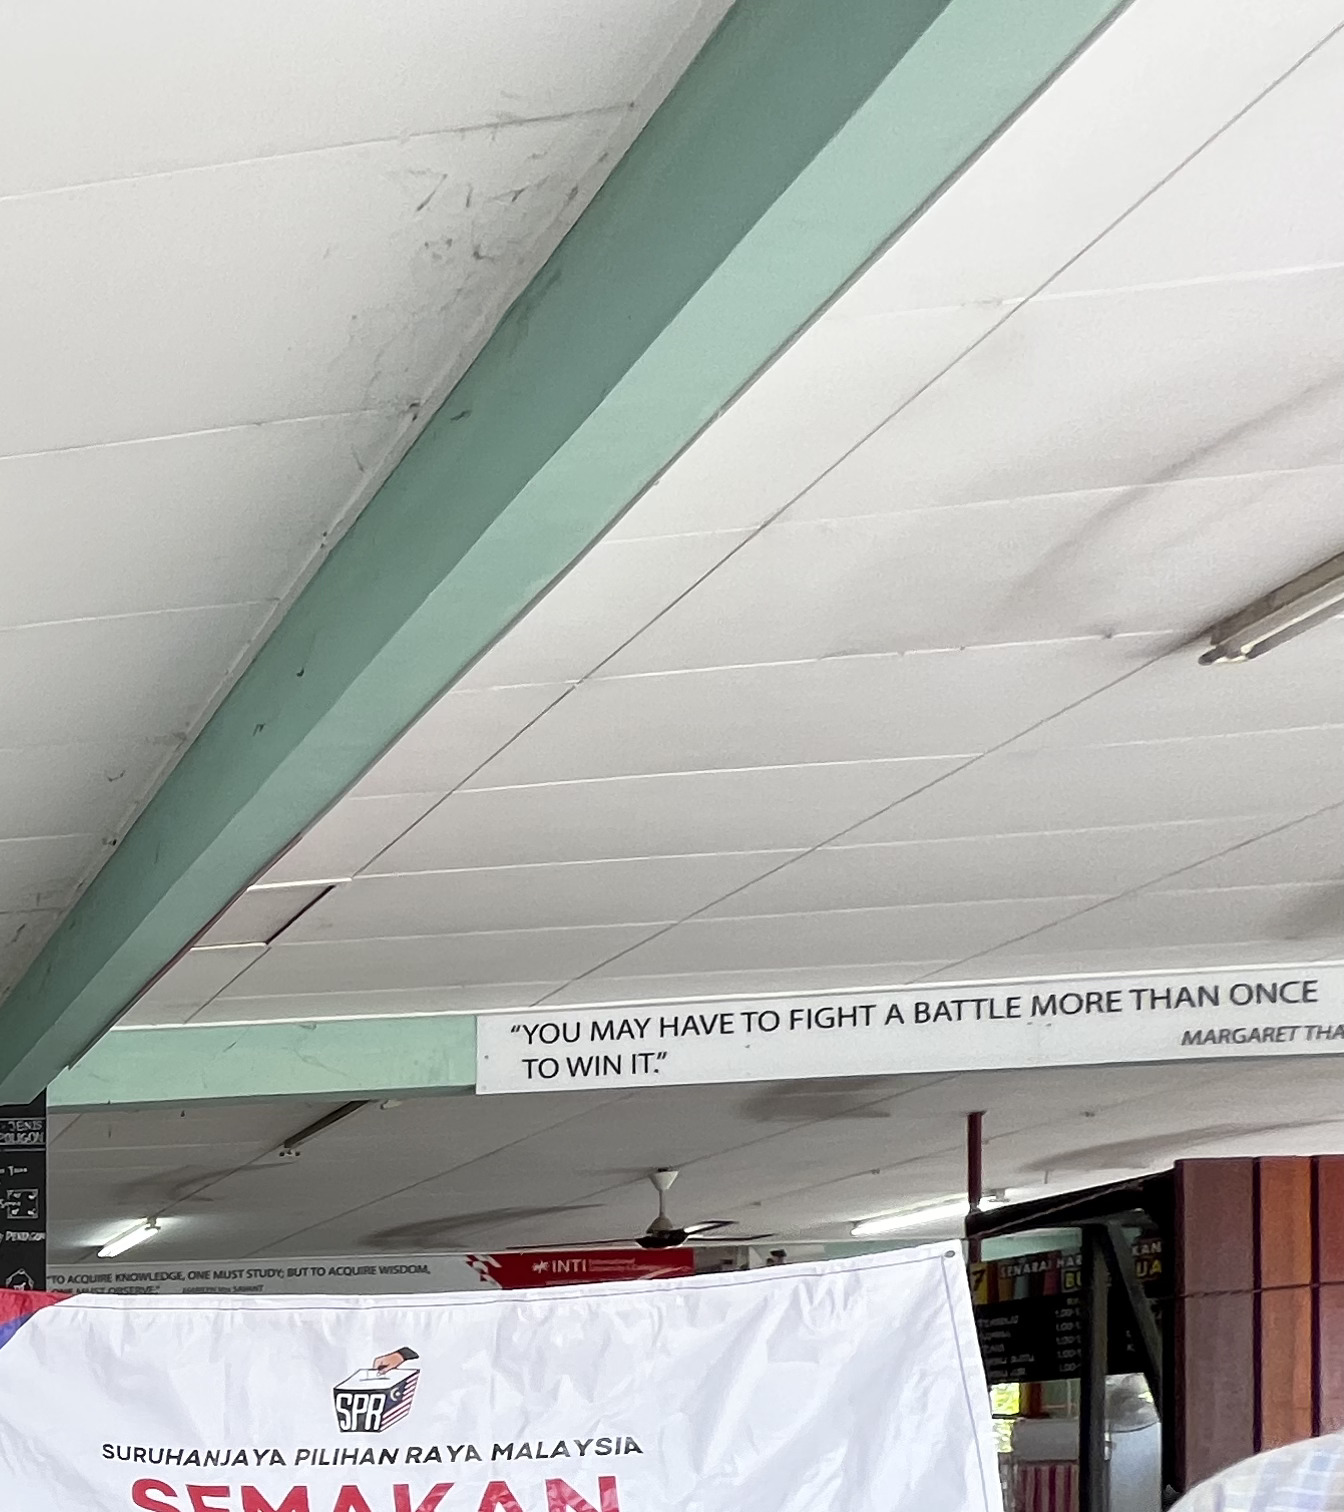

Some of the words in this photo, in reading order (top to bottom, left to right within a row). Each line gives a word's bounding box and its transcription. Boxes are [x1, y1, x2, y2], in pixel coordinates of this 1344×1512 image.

[510, 1021, 581, 1045] "YOU
[590, 1017, 652, 1042] MAY
[659, 1012, 735, 1038] HAVE
[741, 1010, 780, 1033] TO
[789, 1004, 877, 1031] FIGHT
[884, 1003, 905, 1026] A
[914, 995, 1022, 1024] BATTLE
[1030, 989, 1123, 1017] MORE
[1129, 983, 1221, 1010] THAN
[1229, 979, 1319, 1007] ONCE
[1181, 1025, 1298, 1047] MARGARET
[522, 1057, 560, 1080] TO
[565, 1054, 622, 1078] WIN
[631, 1051, 668, 1075] IT."
[67, 1273, 112, 1285] ACQUIRE
[115, 1271, 185, 1282] KNOWLEDGE,
[188, 1270, 210, 1280] ONE
[213, 1269, 245, 1279] MUST
[287, 1267, 308, 1277] BUT
[311, 1266, 326, 1276] TO
[328, 1265, 377, 1276] ACQUIRE
[551, 1258, 587, 1273] INTI
[972, 1269, 986, 1291] 7
[336, 1393, 384, 1432] SPR
[101, 1443, 286, 1467] SURUHANJAYA
[294, 1447, 399, 1467] PILIHAN
[406, 1444, 483, 1465] RAYA
[490, 1436, 644, 1462] MALAYSIA
